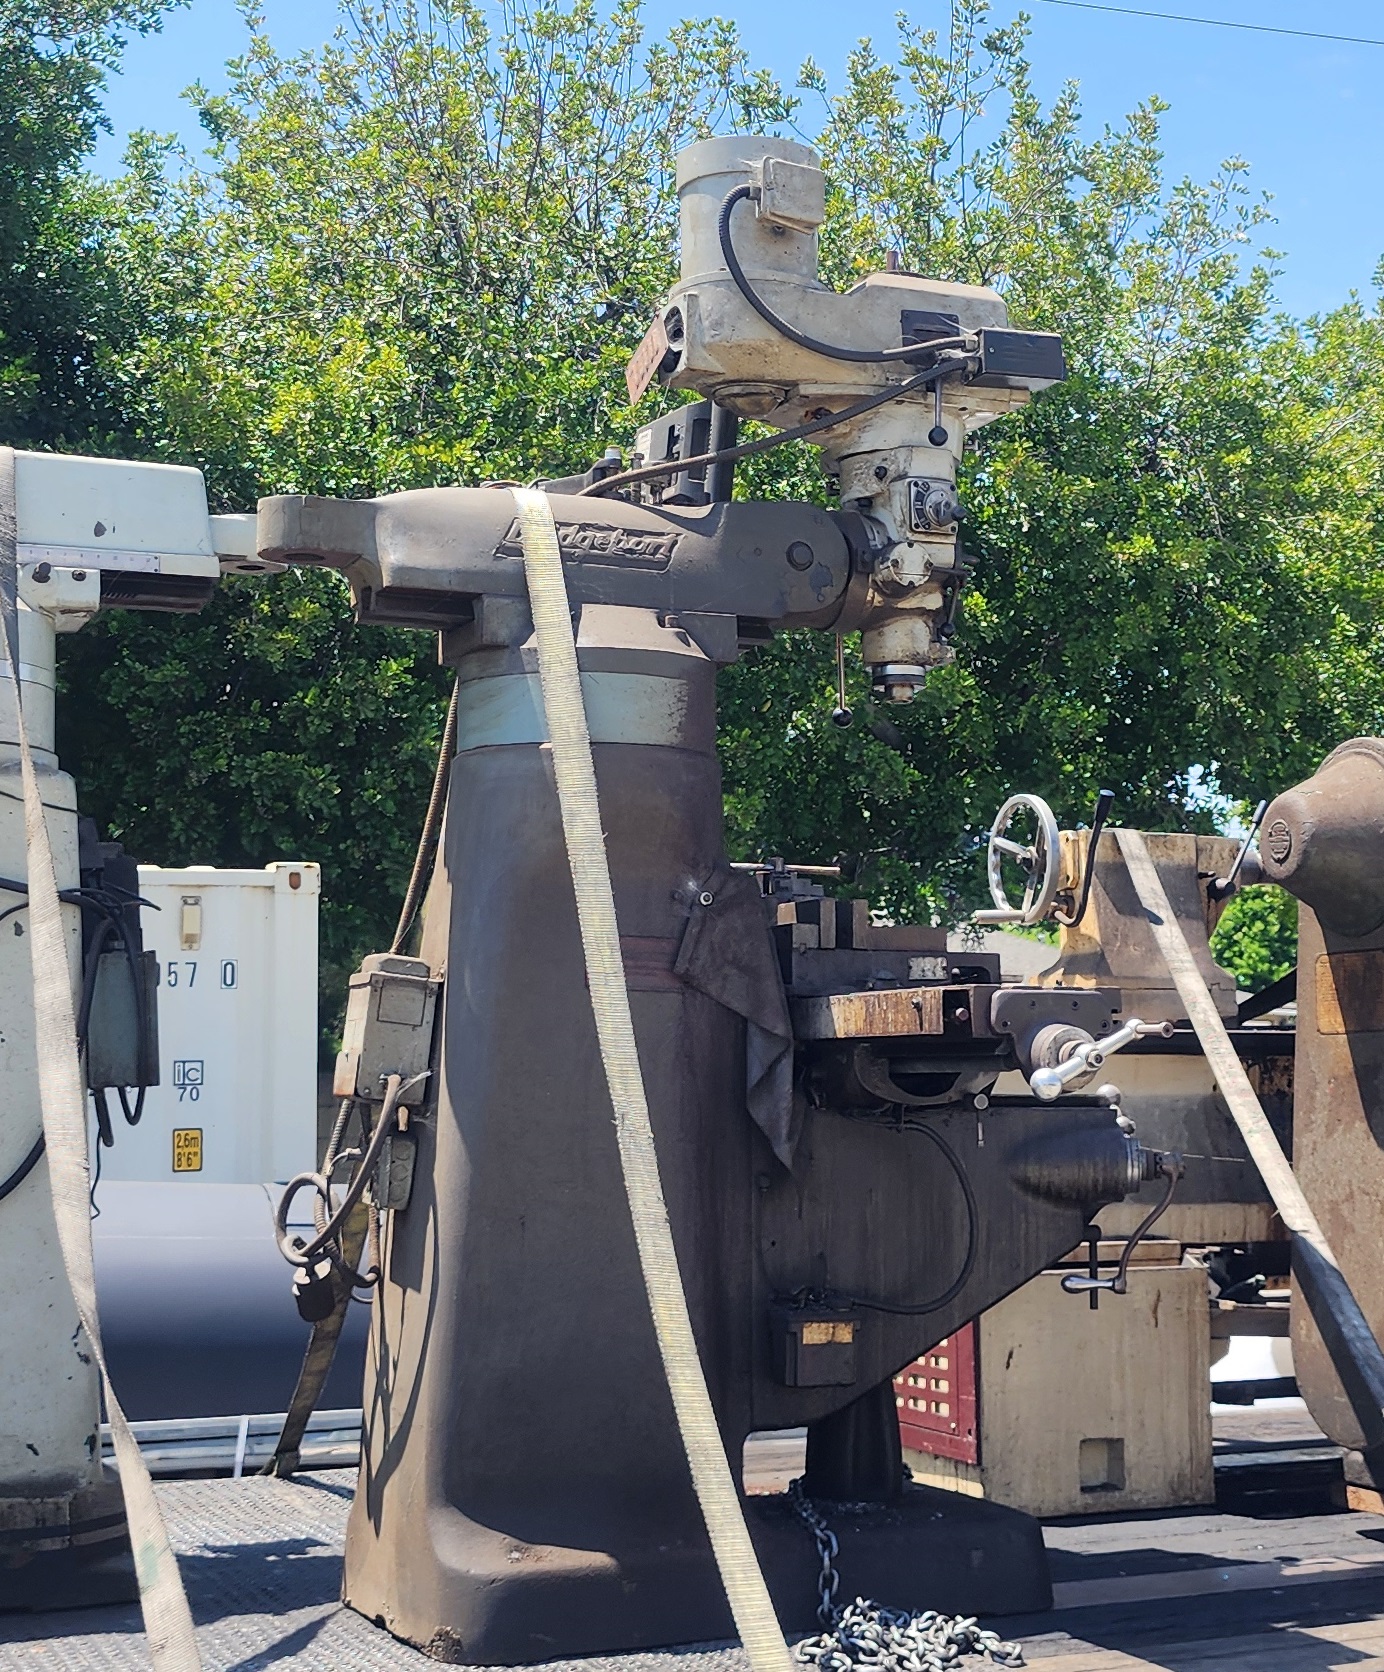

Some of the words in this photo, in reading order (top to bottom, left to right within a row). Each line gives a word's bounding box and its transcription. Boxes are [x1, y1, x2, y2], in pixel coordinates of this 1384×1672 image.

[503, 517, 677, 558] dgeport
[155, 962, 198, 987] 57
[177, 1086, 200, 1102] 70
